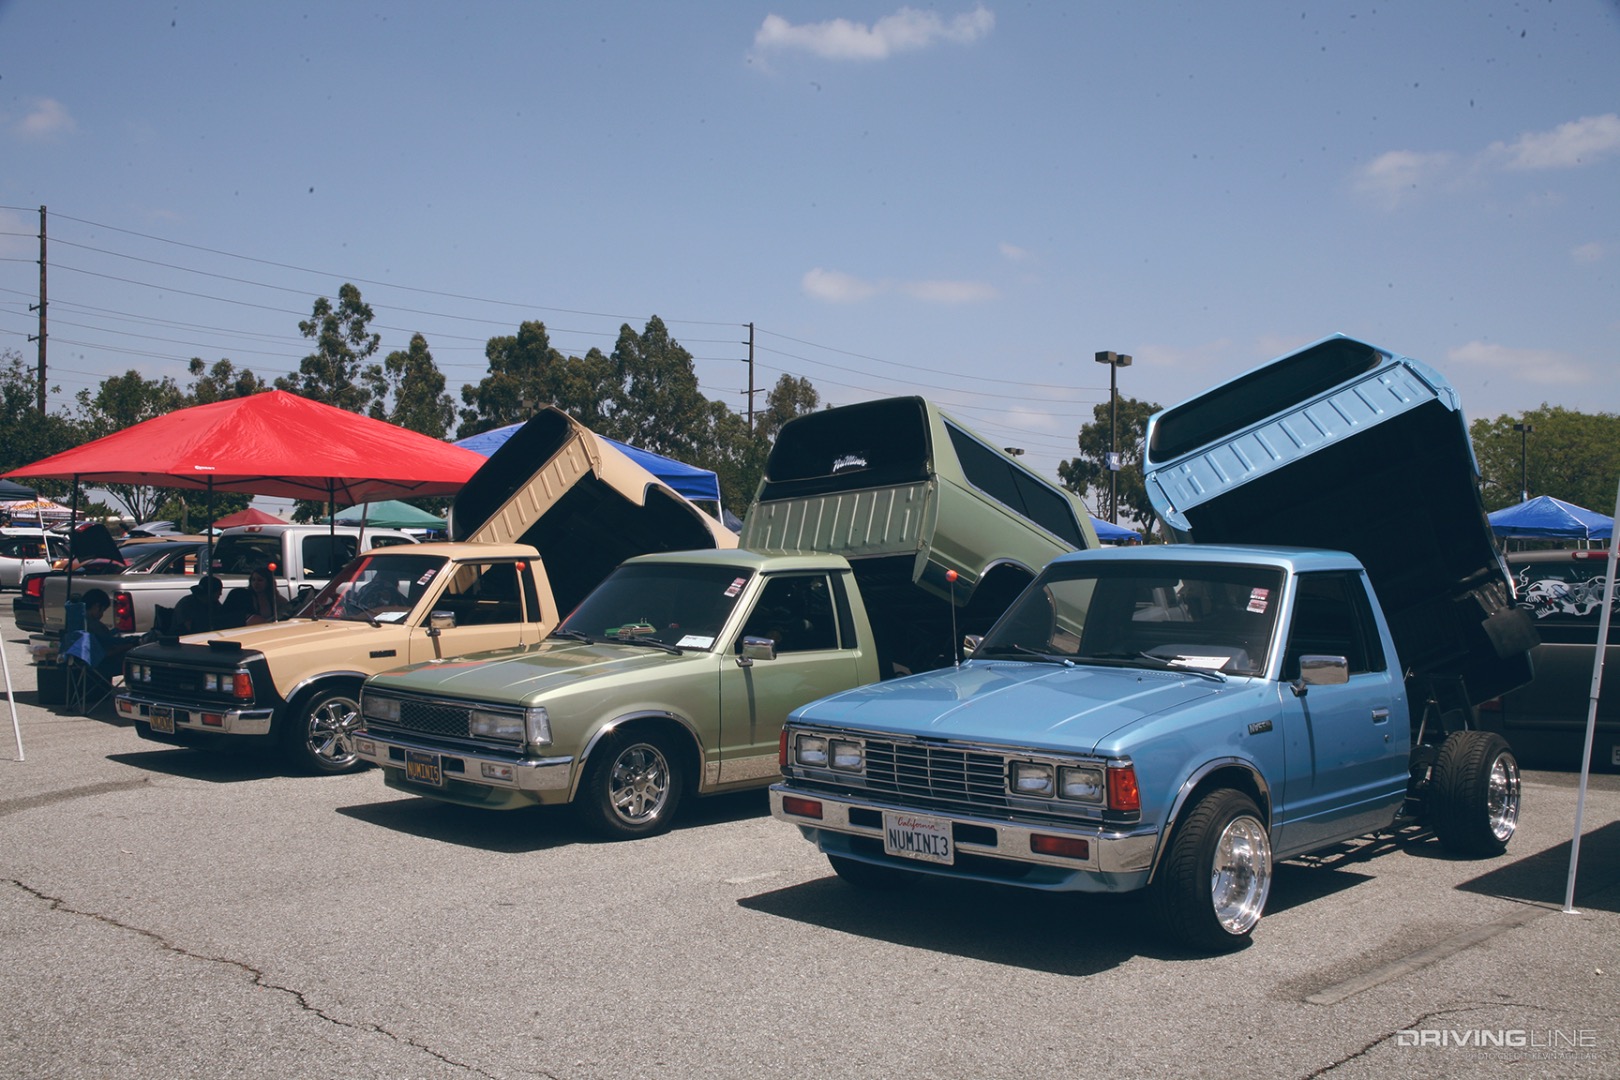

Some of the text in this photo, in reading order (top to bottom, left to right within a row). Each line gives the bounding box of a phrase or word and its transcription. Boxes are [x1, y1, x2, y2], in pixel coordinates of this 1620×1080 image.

[408, 761, 439, 782] NUMINI5
[897, 816, 939, 831] California
[888, 828, 949, 857] NUMINI3
